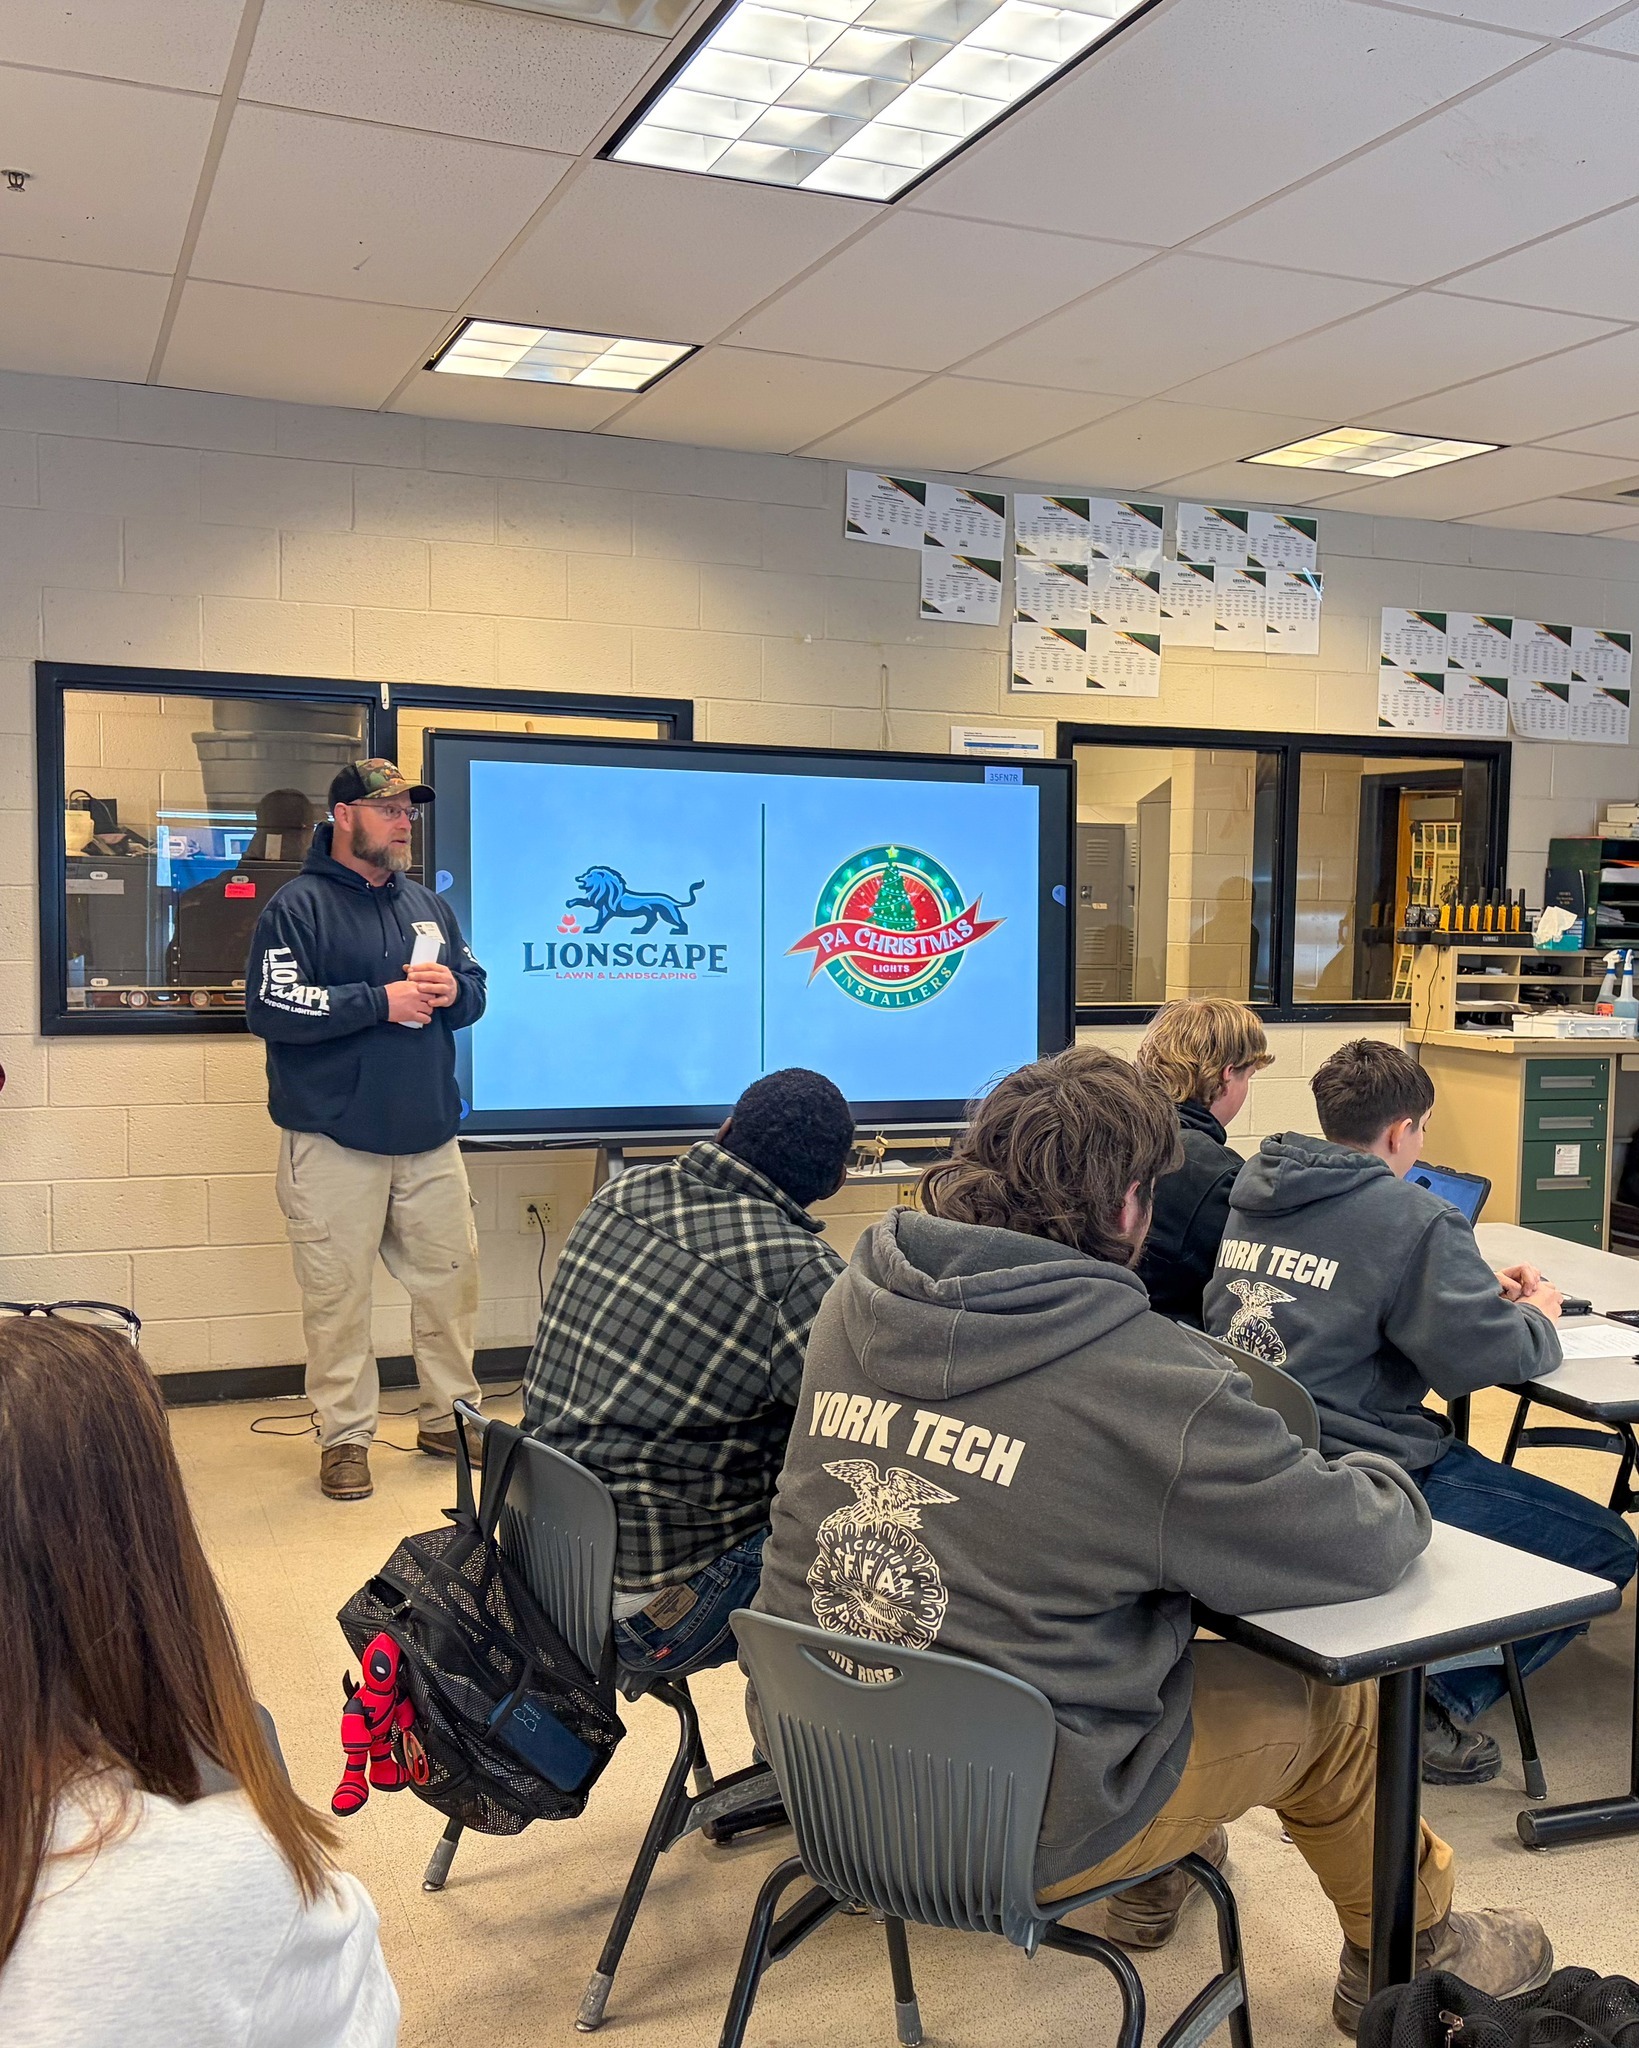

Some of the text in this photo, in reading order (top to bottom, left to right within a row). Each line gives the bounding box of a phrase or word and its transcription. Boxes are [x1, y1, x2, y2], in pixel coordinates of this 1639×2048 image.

[818, 918, 974, 956] PA CHRISTMAS
[522, 942, 728, 974] LIONSCAPE
[609, 972, 698, 980] LANDSCAPING
[872, 964, 910, 973] LIGHTS
[834, 966, 952, 1006] INSTALLERS
[1218, 1239, 1340, 1290] YORK TECH
[808, 1391, 1026, 1487] YORK TECH
[844, 1554, 896, 1594] FFA
[834, 1602, 904, 1642] EDUCATIO
[858, 1664, 894, 1684] ROSE
